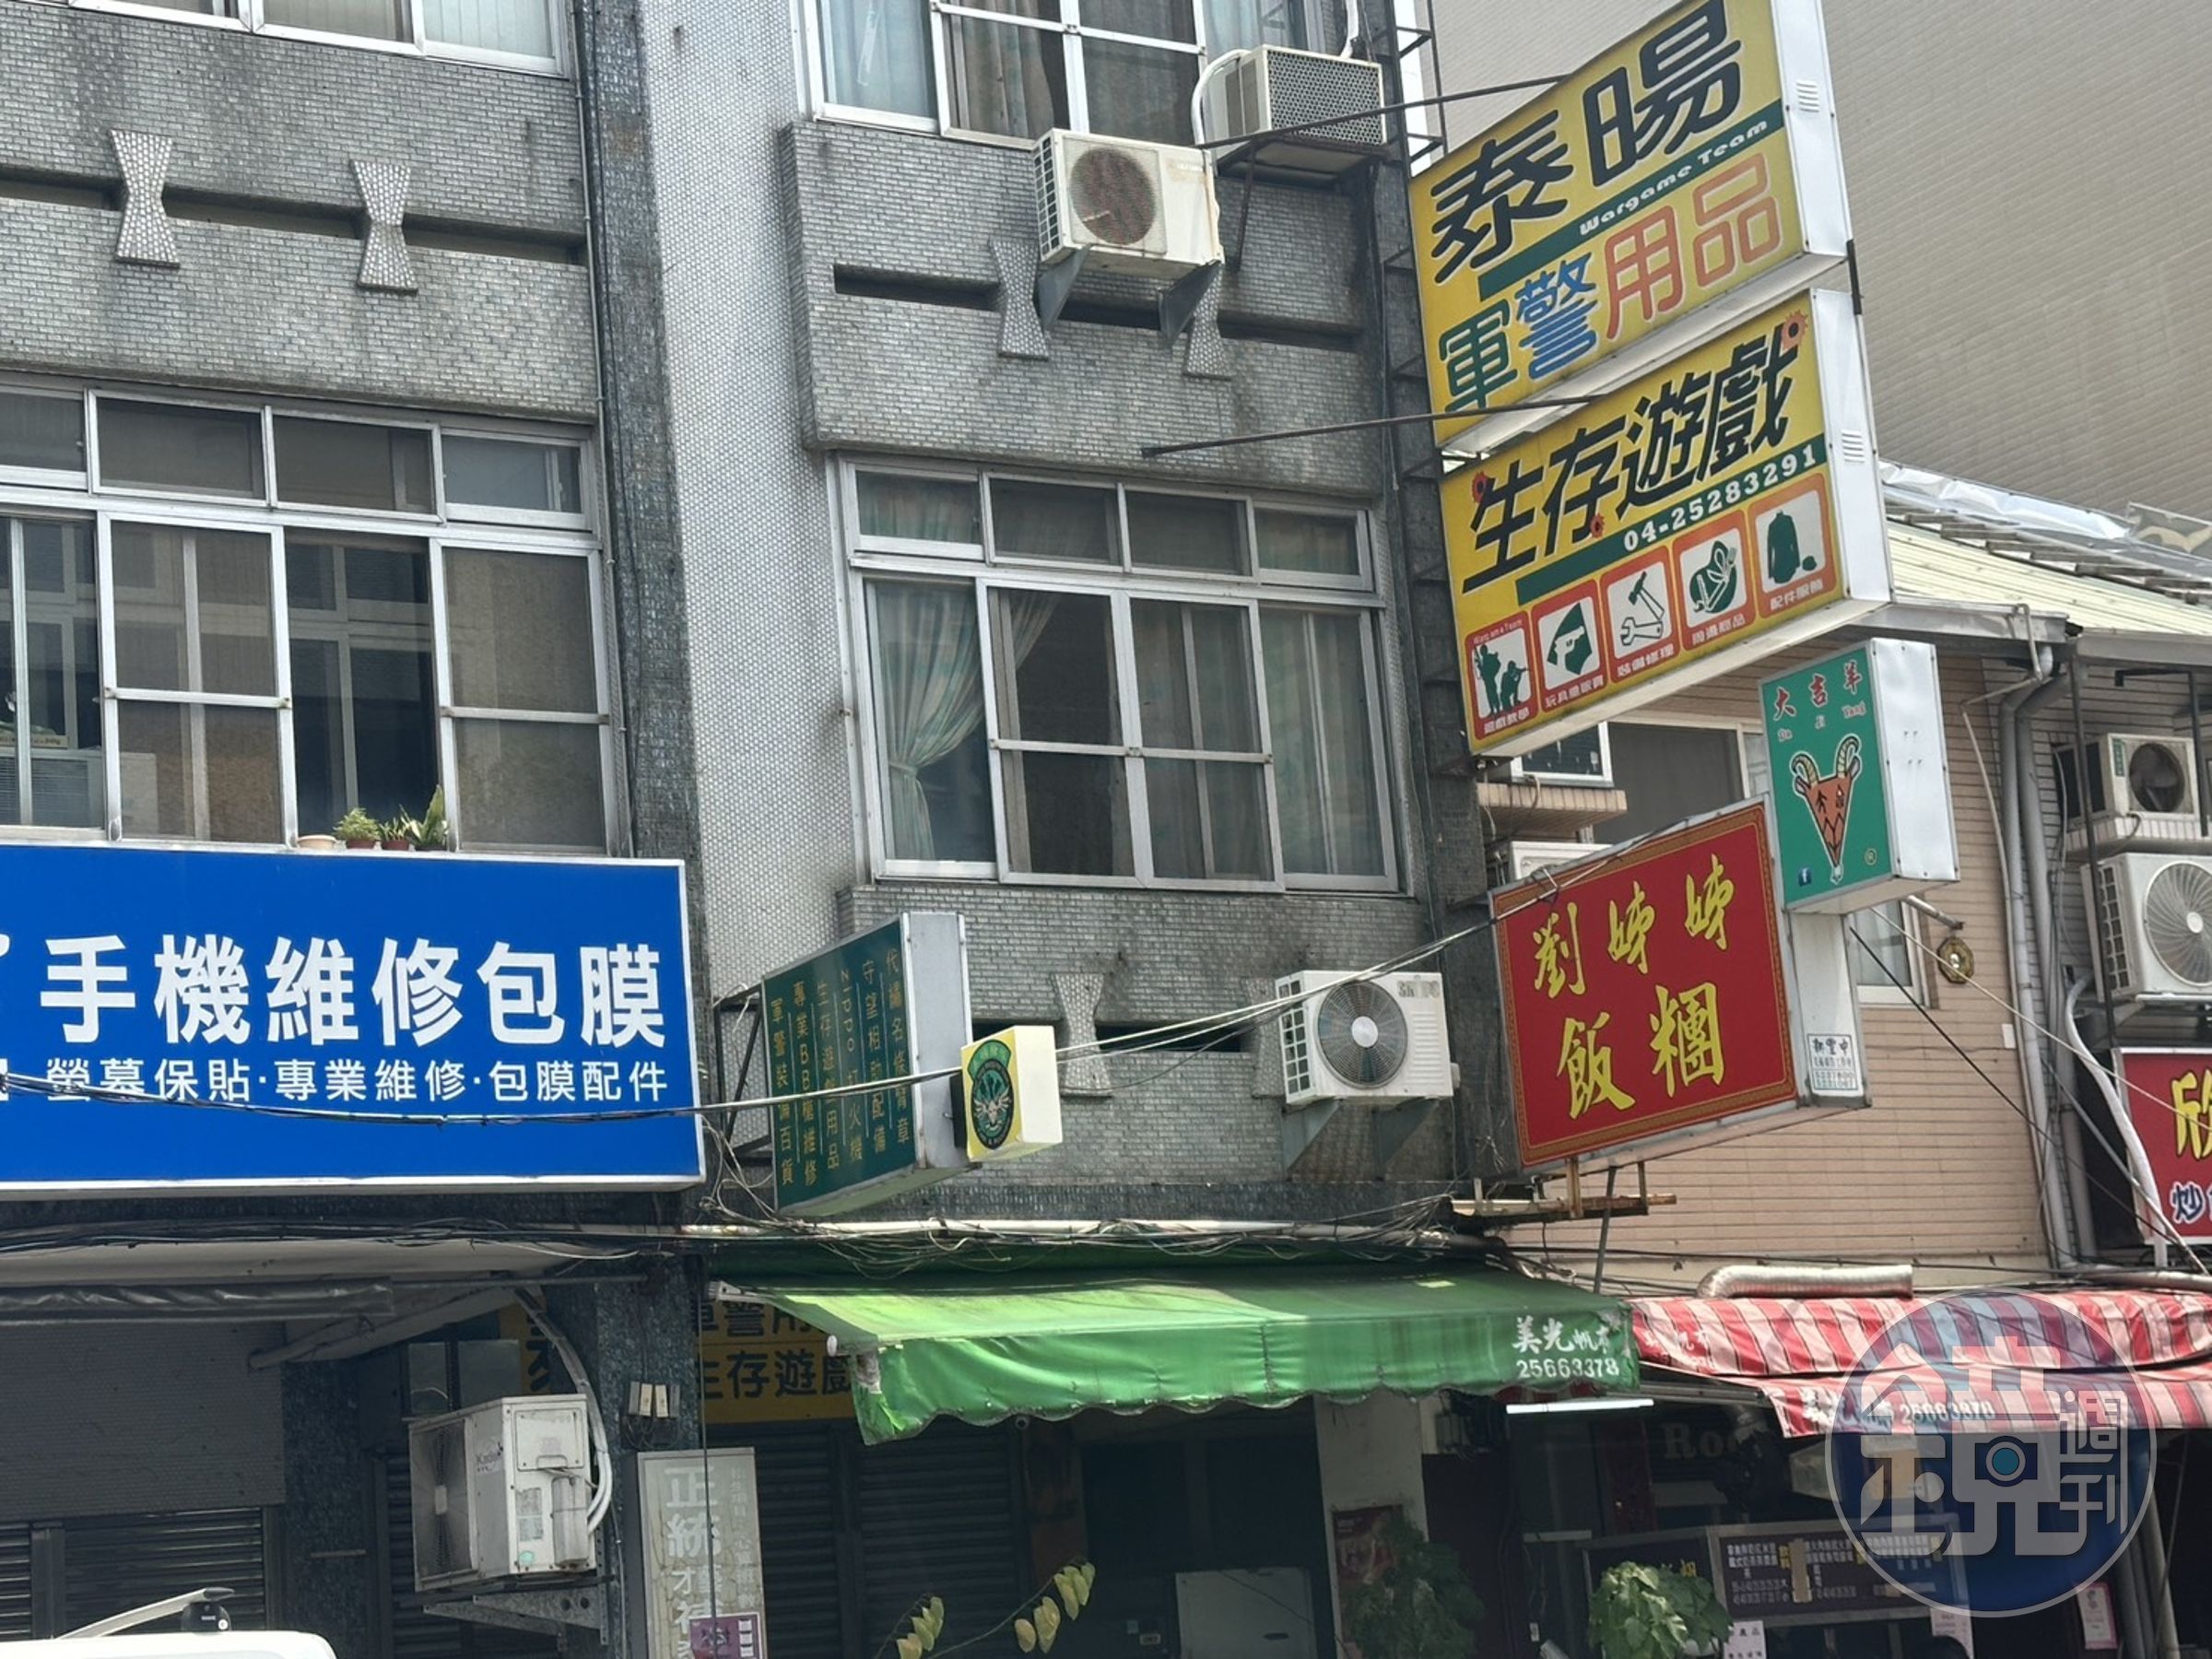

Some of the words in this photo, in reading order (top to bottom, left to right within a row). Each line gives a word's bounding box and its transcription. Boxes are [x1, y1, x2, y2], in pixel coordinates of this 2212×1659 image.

[1579, 165, 1690, 236] Wargame
[1698, 119, 1768, 166] Team
[1439, 155, 1781, 414] 軍警用品
[1461, 324, 1799, 594] 生存遊戲
[1624, 444, 1817, 552] 04-25283291
[1773, 659, 1862, 722] 大吉羊
[40, 933, 667, 1048] 手機維修包膜
[1557, 982, 1725, 1120] 飯糰
[1516, 1358, 1619, 1380] 25663378
